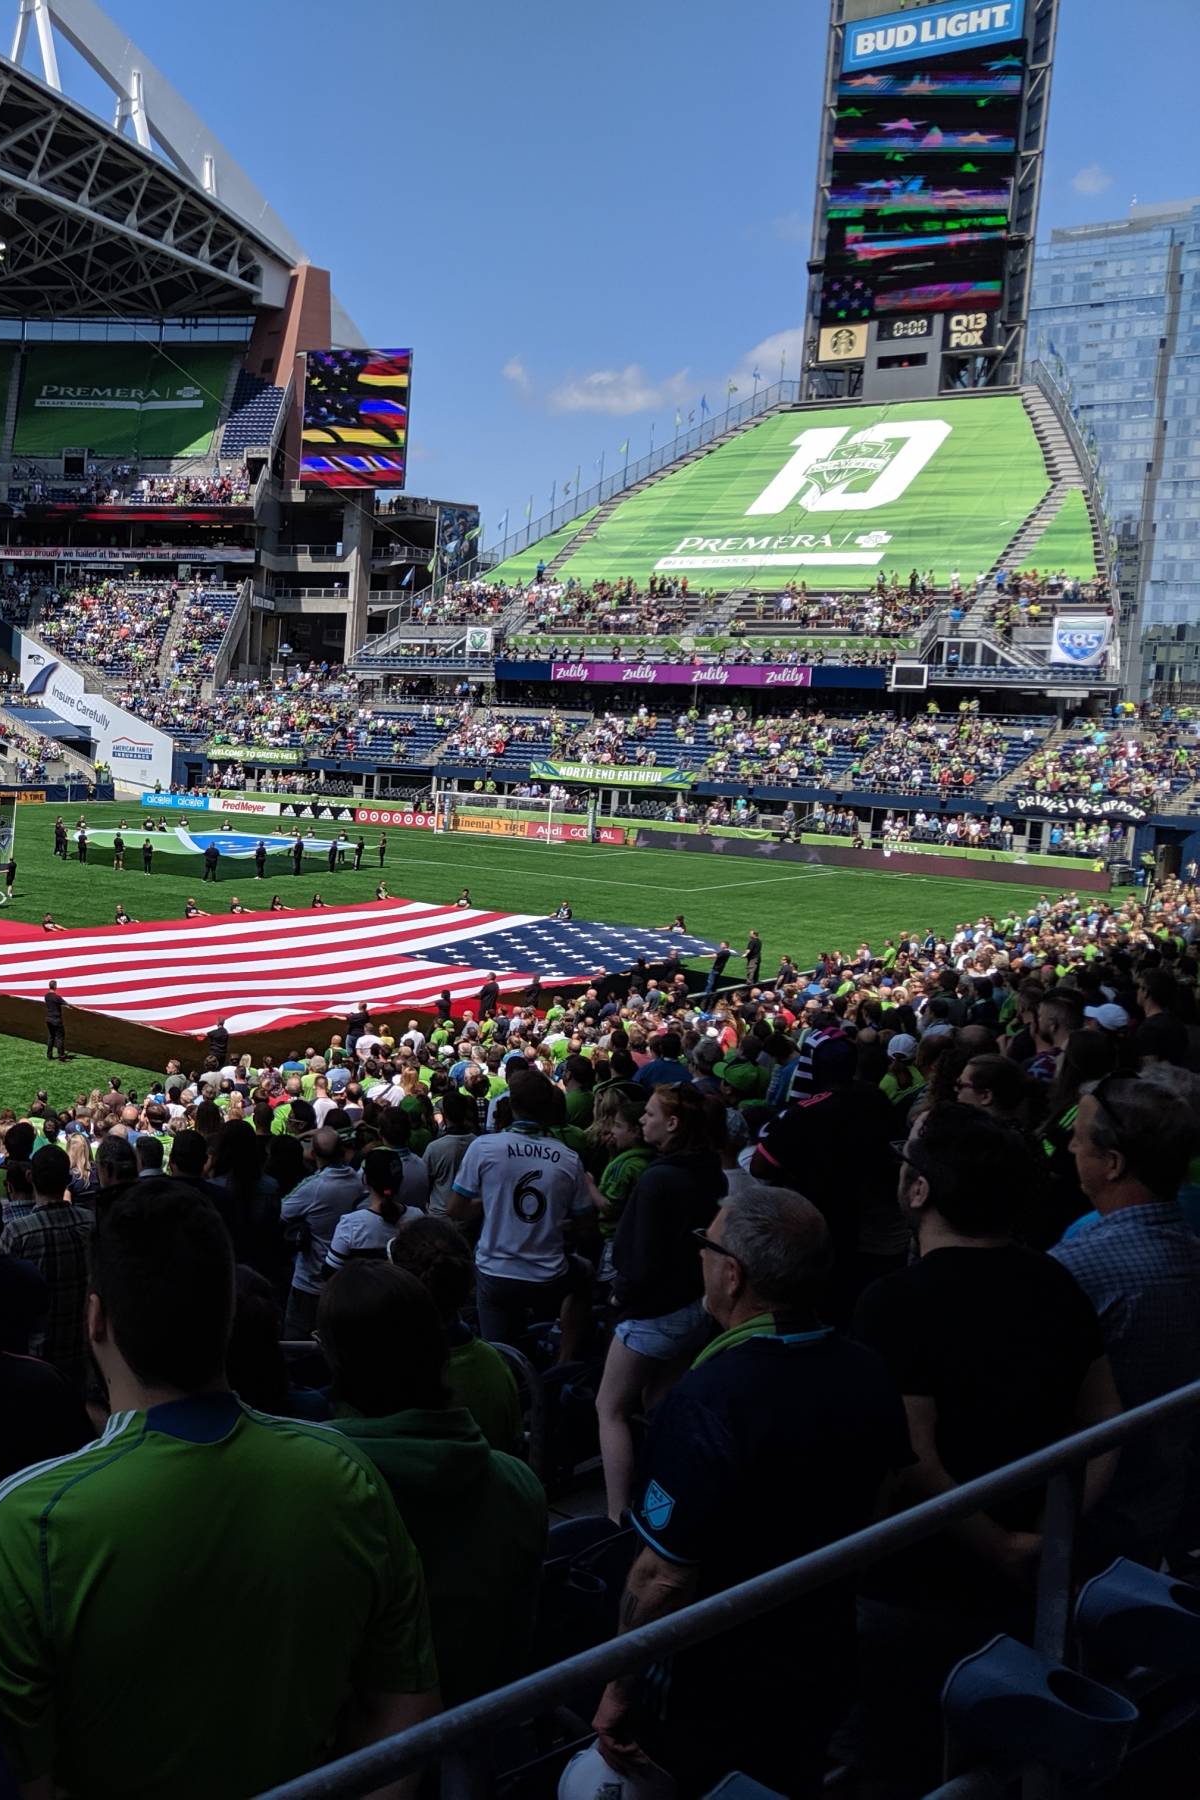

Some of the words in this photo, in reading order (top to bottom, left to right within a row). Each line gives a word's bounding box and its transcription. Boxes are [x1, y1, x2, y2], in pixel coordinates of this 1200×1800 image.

[856, 25, 917, 55] BUD
[920, 4, 1011, 41] LIGHT
[893, 320, 928, 337] 0:00
[951, 312, 988, 331] Q13
[951, 330, 984, 348] FOX
[40, 384, 161, 400] PREMERA
[745, 419, 953, 516] 10
[671, 534, 832, 555] PREMERA
[4, 549, 23, 557] What
[34, 549, 61, 559] proudly
[75, 550, 97, 558] hailed
[121, 551, 154, 560] twilight's
[156, 551, 169, 559] last
[1059, 631, 1100, 650] 485
[52, 684, 75, 707] Insure
[76, 699, 111, 731] Carefully
[113, 744, 136, 752] AMERICAN
[137, 746, 153, 754] FAMILY
[211, 748, 245, 758] WELCOME
[245, 750, 256, 758] TO
[257, 751, 280, 759] GREEN
[280, 751, 299, 760] HELL
[559, 766, 595, 778] NORTH
[595, 768, 615, 780] END
[617, 769, 663, 783] FAITHFUL
[1018, 796, 1057, 811] DRINK
[537, 825, 563, 836] Audi
[508, 1144, 561, 1164] ALONSO
[513, 1169, 547, 1225] 6
